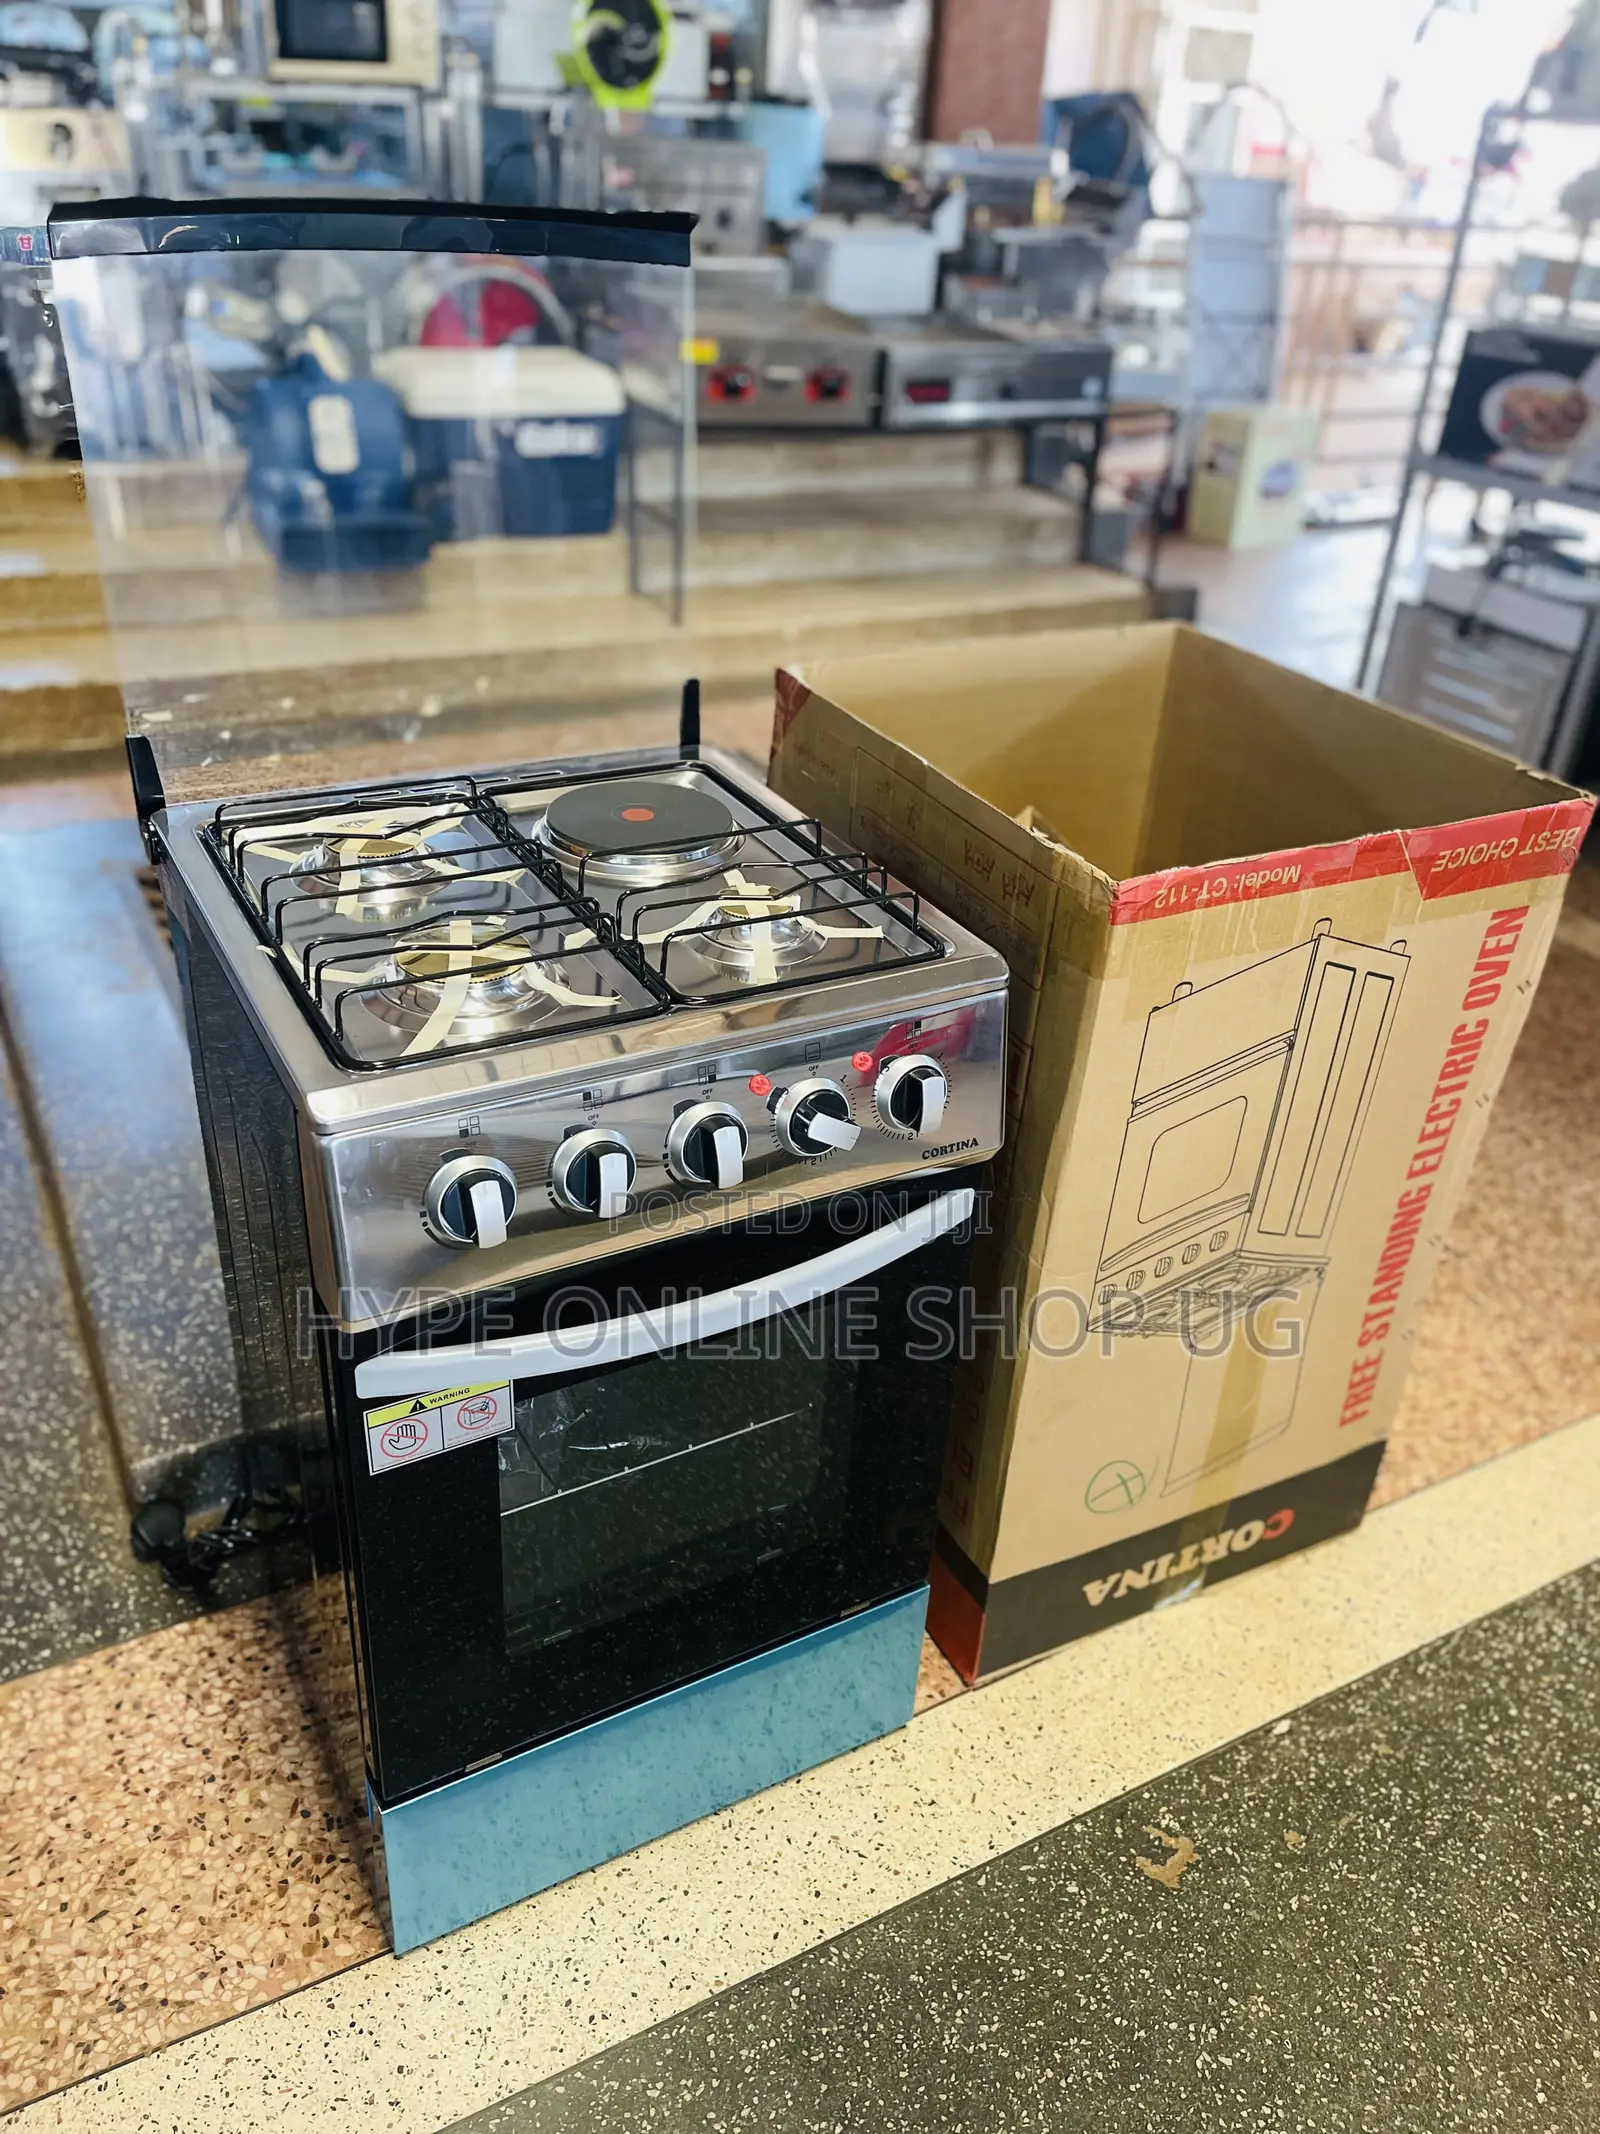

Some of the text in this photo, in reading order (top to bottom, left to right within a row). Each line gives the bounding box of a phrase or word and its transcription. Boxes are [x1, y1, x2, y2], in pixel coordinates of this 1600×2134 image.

[1430, 826, 1581, 873] BEST CHOICE
[1154, 864, 1301, 909] Model: CT-112
[701, 1087, 714, 1095] OFF
[587, 1113, 600, 1121] OFF
[921, 1137, 980, 1161] CORTINA
[1339, 905, 1530, 1428] FREE STANDING ELECTRIC OVEN
[429, 1387, 470, 1405] WARNING
[1082, 1507, 1295, 1607] CORTINA
